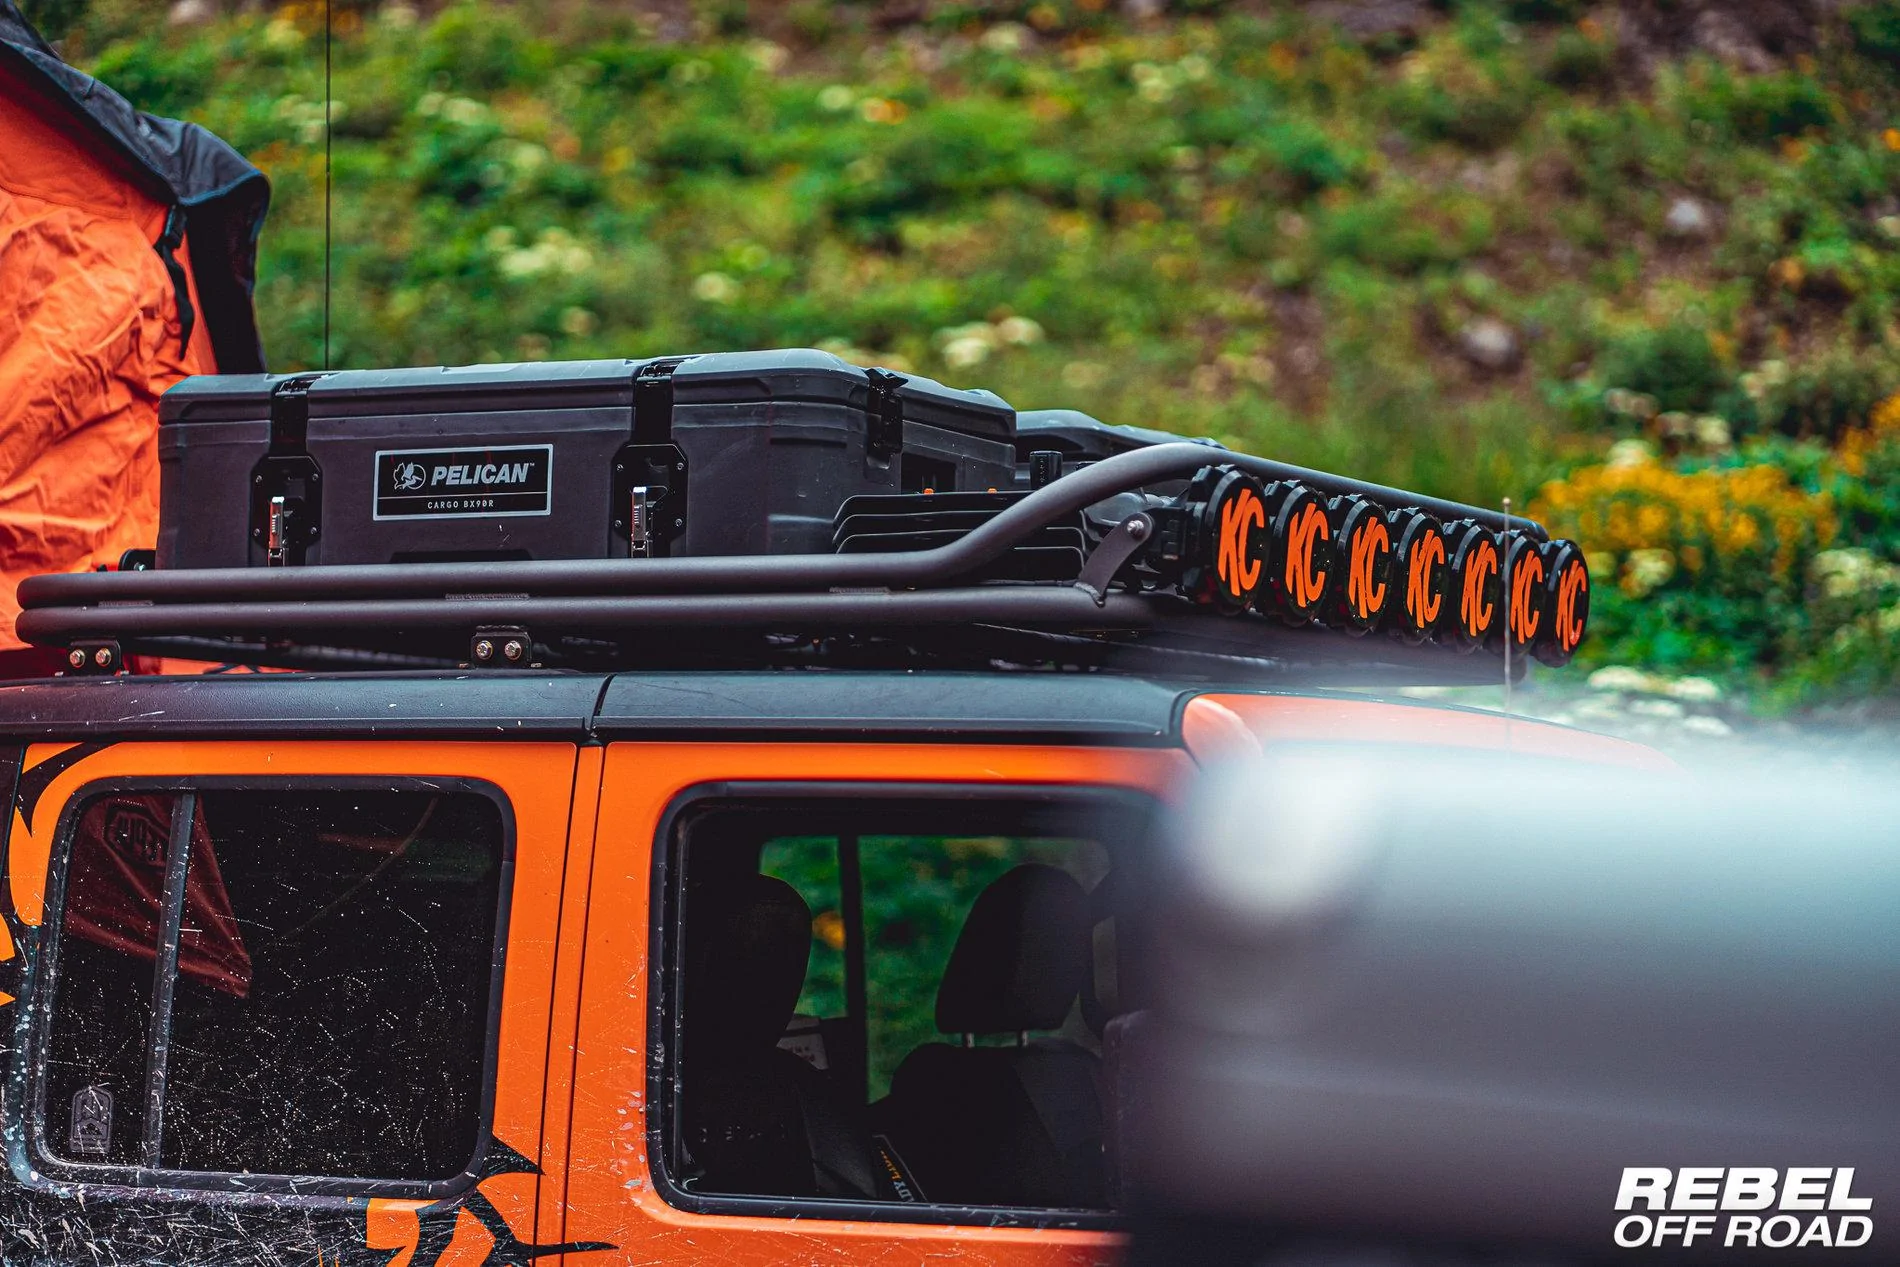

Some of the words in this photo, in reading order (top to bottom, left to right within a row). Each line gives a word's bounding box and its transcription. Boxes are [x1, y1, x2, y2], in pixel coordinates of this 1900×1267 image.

[427, 500, 459, 509] CARGO
[463, 499, 495, 508] BX90R
[1217, 488, 1265, 597] KC
[1285, 502, 1329, 608] KC
[1348, 516, 1389, 620] KC
[1406, 529, 1445, 629] KC
[1461, 540, 1497, 637] KC
[1510, 550, 1543, 645] KC
[1555, 559, 1587, 652] KC
